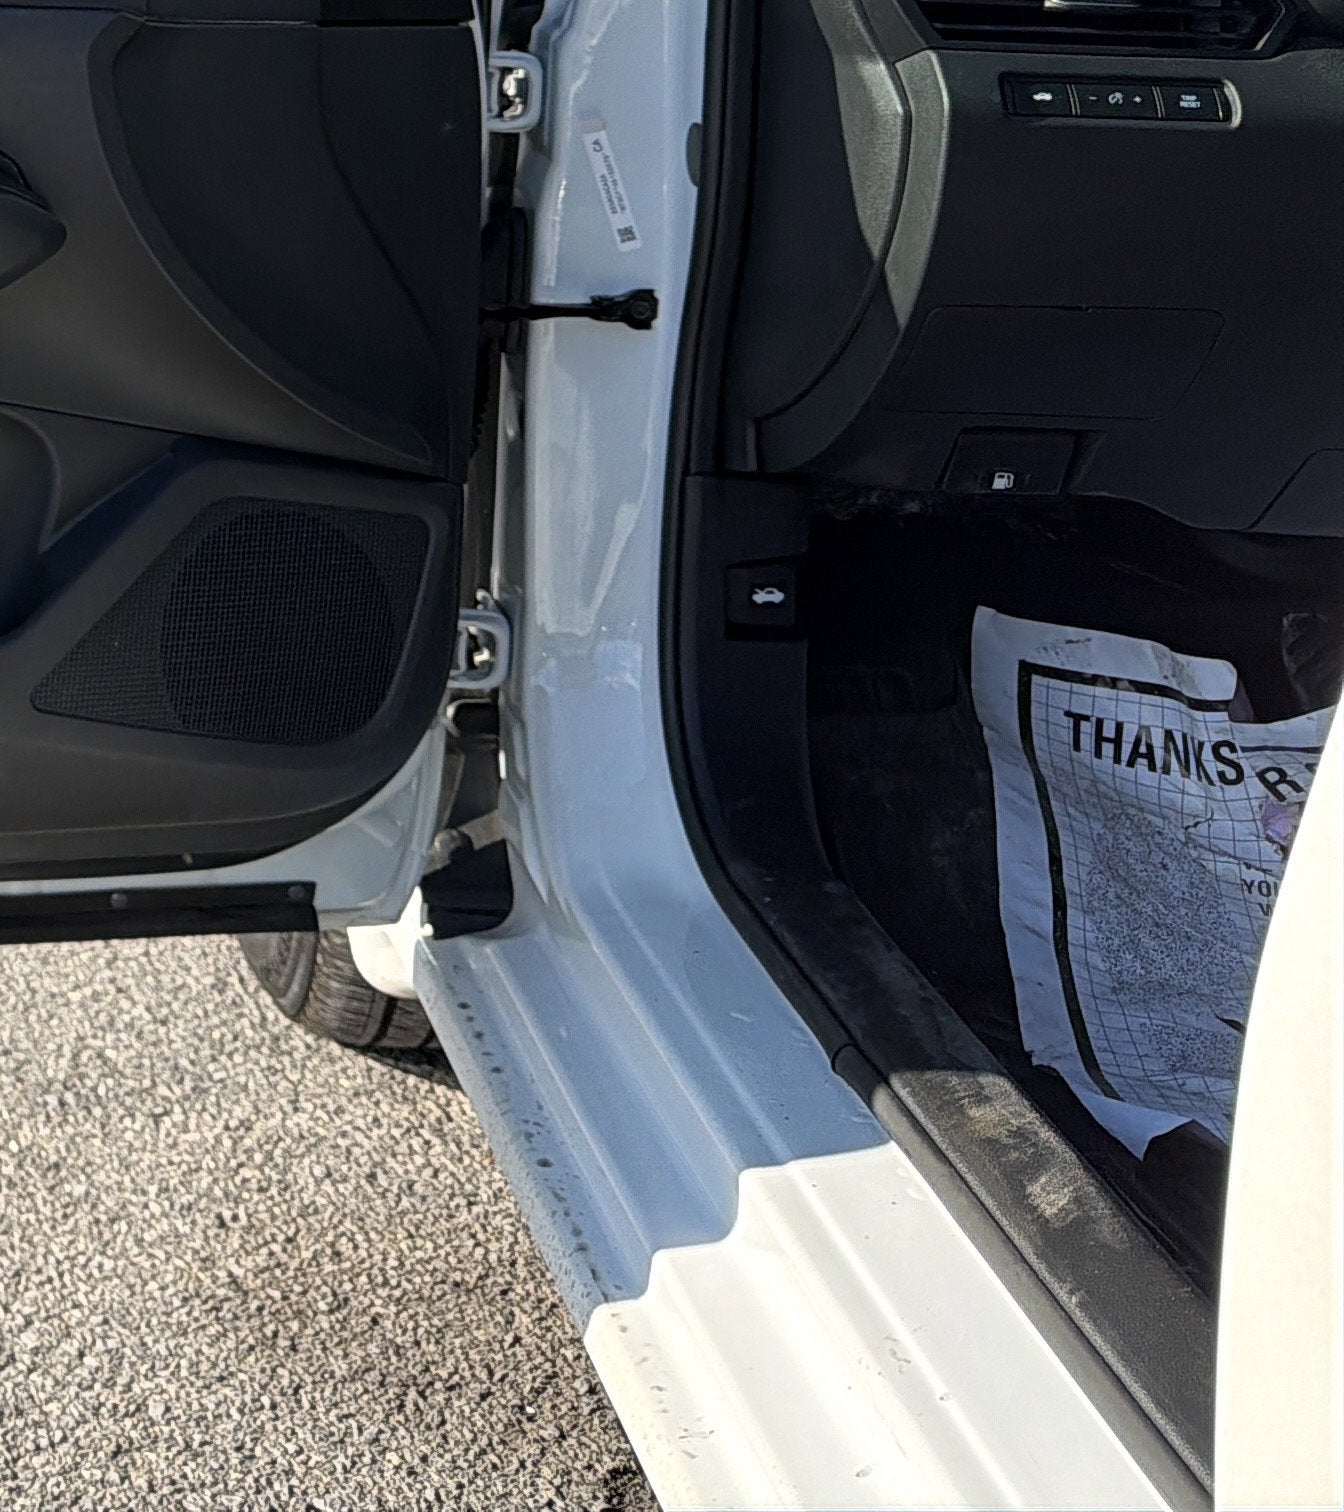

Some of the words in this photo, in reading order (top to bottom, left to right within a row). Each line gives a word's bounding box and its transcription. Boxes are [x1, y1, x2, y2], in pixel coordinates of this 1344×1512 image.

[1063, 710, 1244, 786] THANKS
[1255, 762, 1319, 803] R
[1241, 878, 1279, 898] YO
